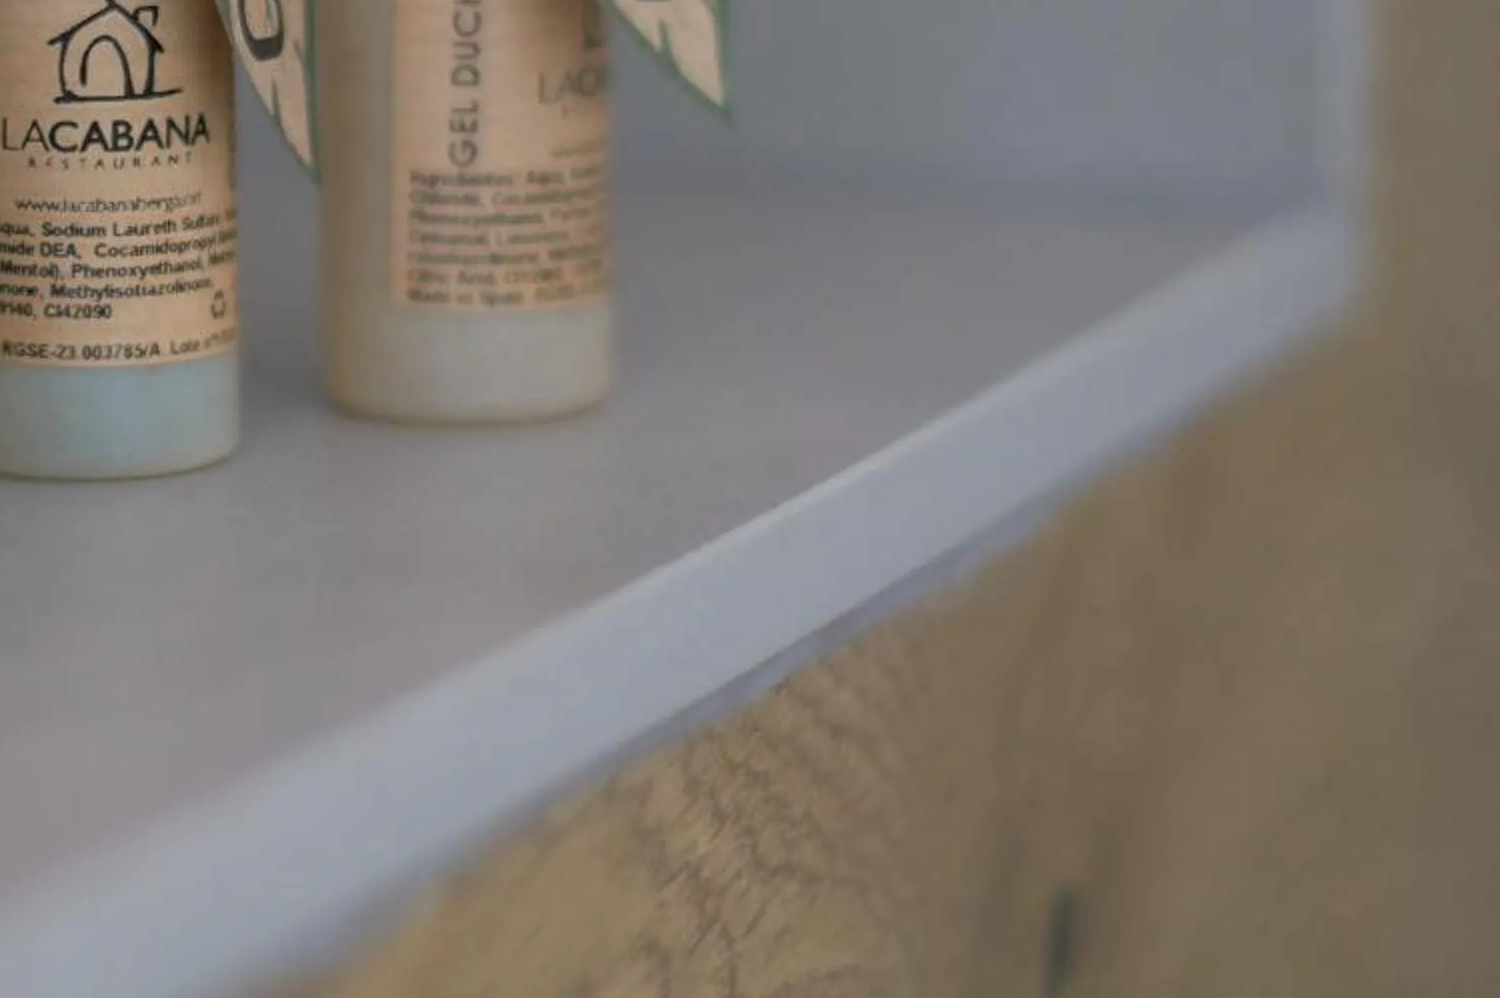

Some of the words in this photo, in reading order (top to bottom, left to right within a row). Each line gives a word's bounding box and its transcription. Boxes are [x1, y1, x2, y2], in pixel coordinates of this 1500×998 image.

[1, 112, 210, 152] LACABANA
[447, 99, 480, 169] GEL
[26, 153, 192, 171] RESTAURANT
[42, 221, 107, 238] Sodium
[112, 219, 177, 237] Laureth
[40, 241, 83, 259] DEA,
